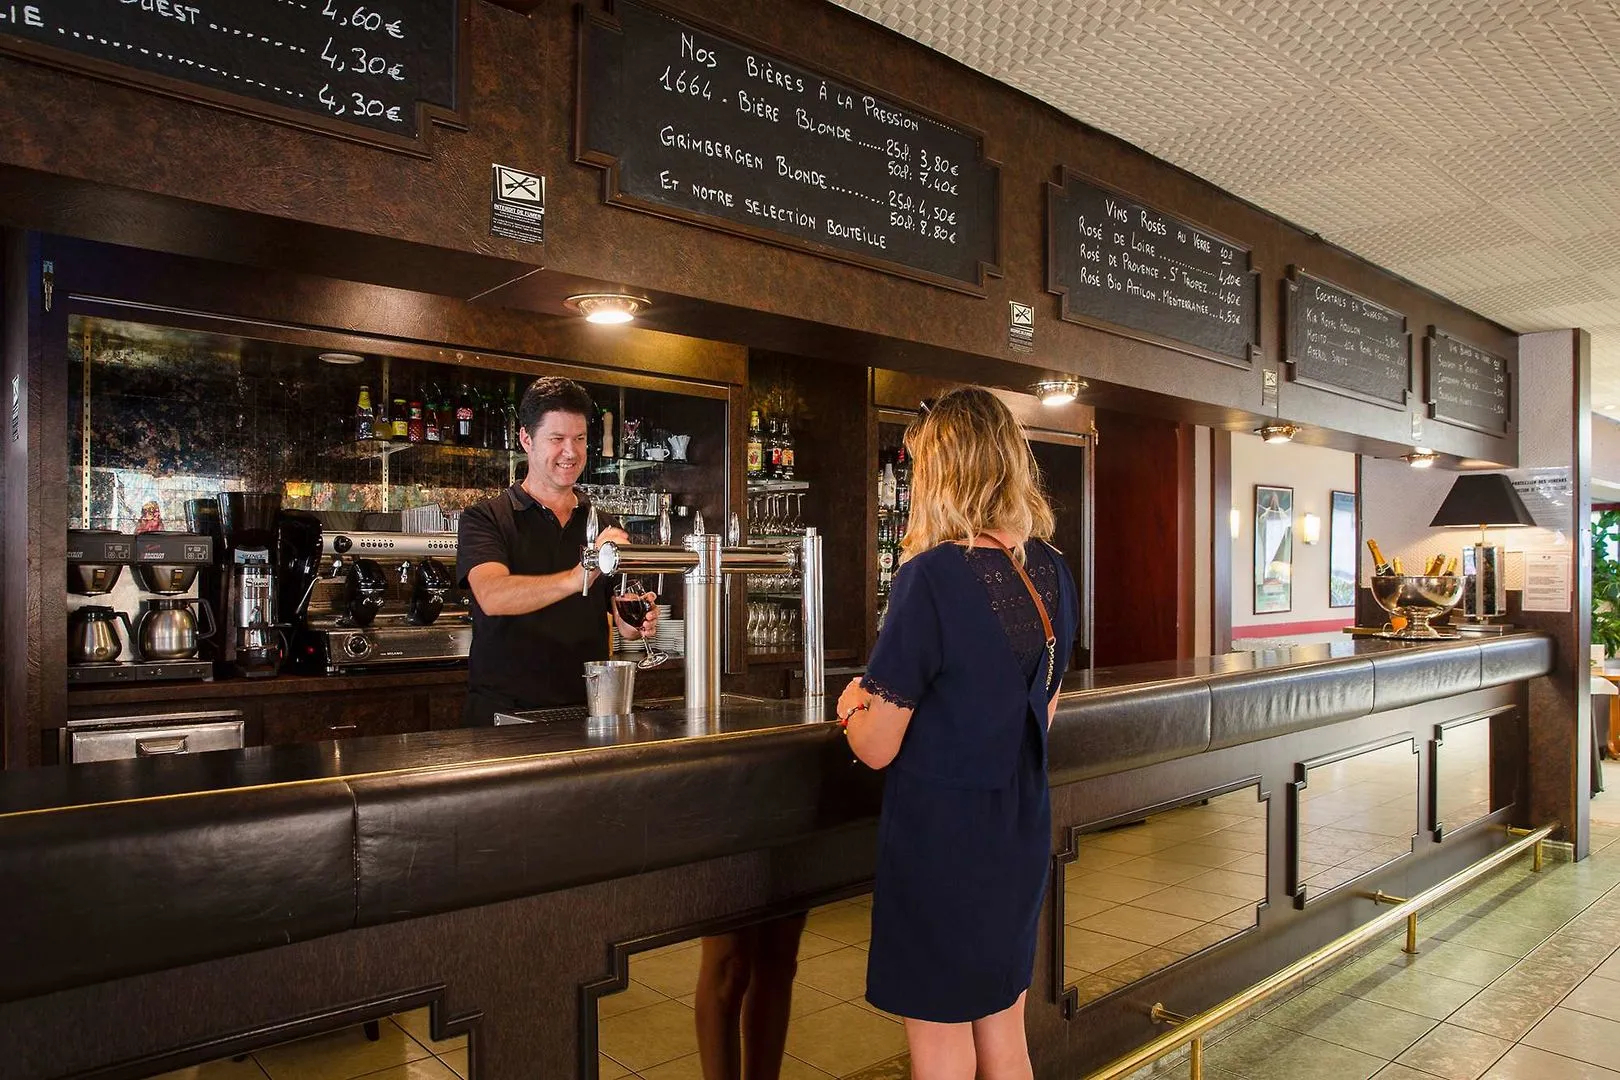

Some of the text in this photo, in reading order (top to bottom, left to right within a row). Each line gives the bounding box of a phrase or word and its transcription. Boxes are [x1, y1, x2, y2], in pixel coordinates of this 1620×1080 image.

[320, 36, 406, 81] 4,30€
[659, 65, 712, 101] 1664
[318, 83, 403, 123] 4,30€
[920, 149, 959, 176] 3,80€
[919, 172, 958, 196] 7,40€
[919, 198, 957, 225] 4,50€
[920, 221, 957, 245] 8,80€
